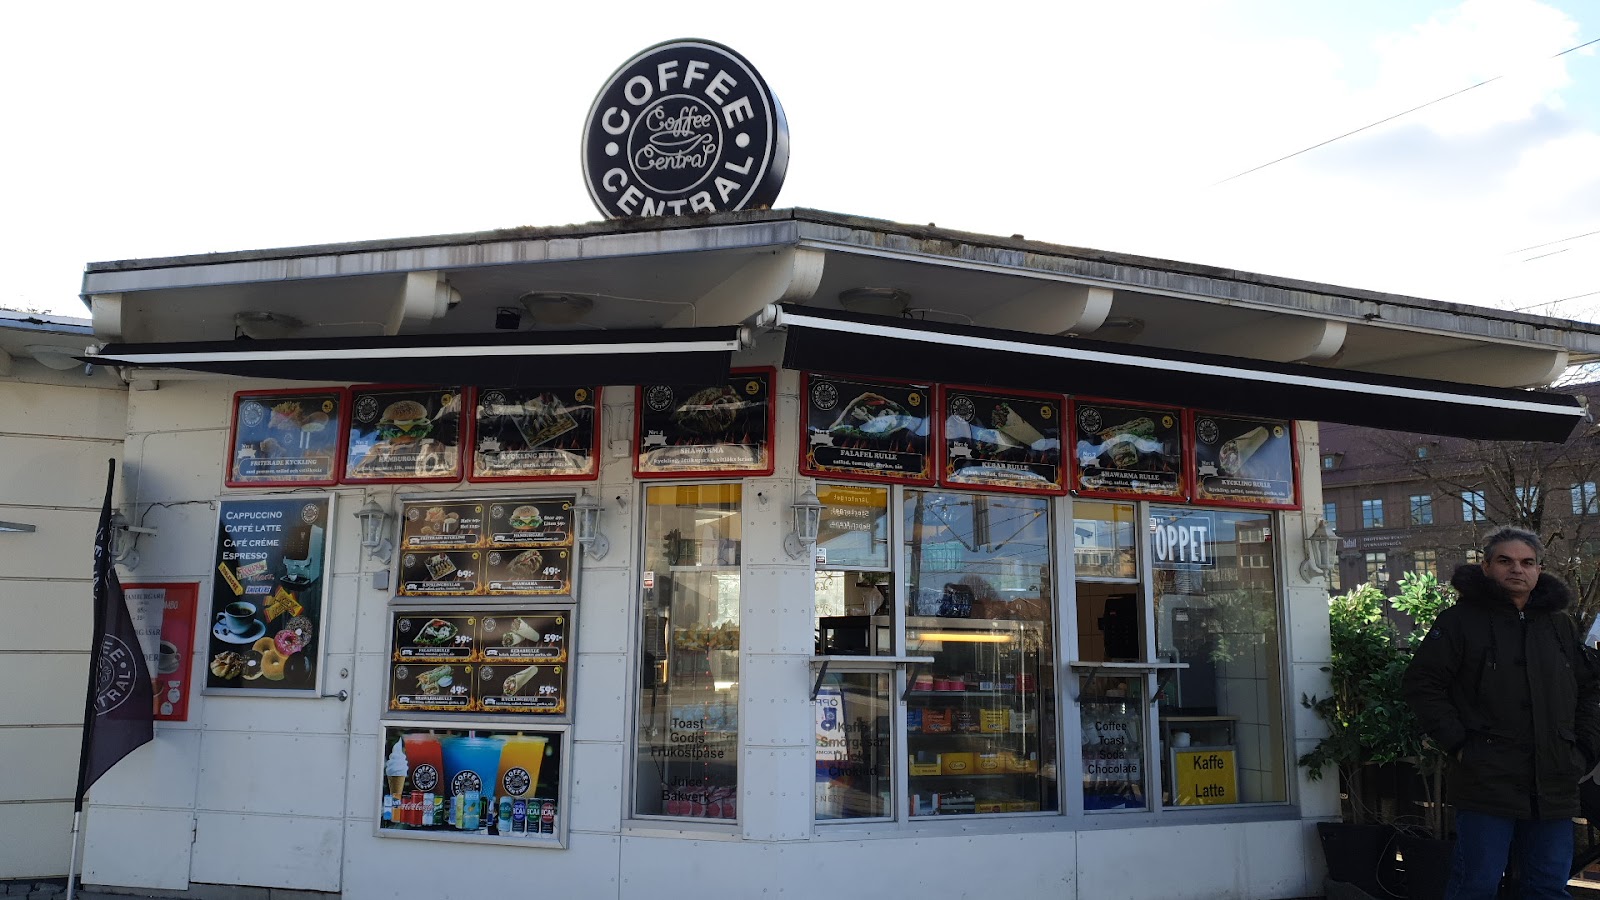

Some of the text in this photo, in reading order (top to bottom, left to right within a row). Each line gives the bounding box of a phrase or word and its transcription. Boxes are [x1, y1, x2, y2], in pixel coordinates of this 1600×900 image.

[602, 60, 754, 135] COFFEE
[646, 105, 711, 137] Coffee
[635, 143, 716, 170] Central
[603, 156, 754, 217] CENTRAL
[840, 450, 898, 460] FALAFEL RULLE
[1100, 471, 1138, 480] SHAWARMA
[226, 511, 283, 520] CAPPUCCINO
[224, 523, 254, 533] CAFFÉ
[223, 538, 248, 548] CAFÉ
[1156, 518, 1208, 562] ÖPPET
[222, 551, 268, 560] ESPRESSO
[456, 570, 474, 578] 69:-
[542, 566, 560, 576] 49:-
[454, 636, 472, 644] 39:-
[544, 634, 562, 642] 59:-
[450, 686, 468, 694] 49:-
[538, 686, 558, 694] 59:-
[672, 718, 704, 729] Toast
[838, 720, 868, 733] Kaffe
[1095, 722, 1127, 732] Coffee
[670, 732, 705, 744] Godis
[1098, 736, 1125, 746] Toast
[1100, 750, 1124, 760] Soda
[1194, 754, 1224, 770] Kaffe
[1088, 764, 1137, 775] Chocolate
[670, 776, 702, 787] Juice
[662, 790, 710, 802] Bakverk
[1196, 784, 1224, 798] Latte
